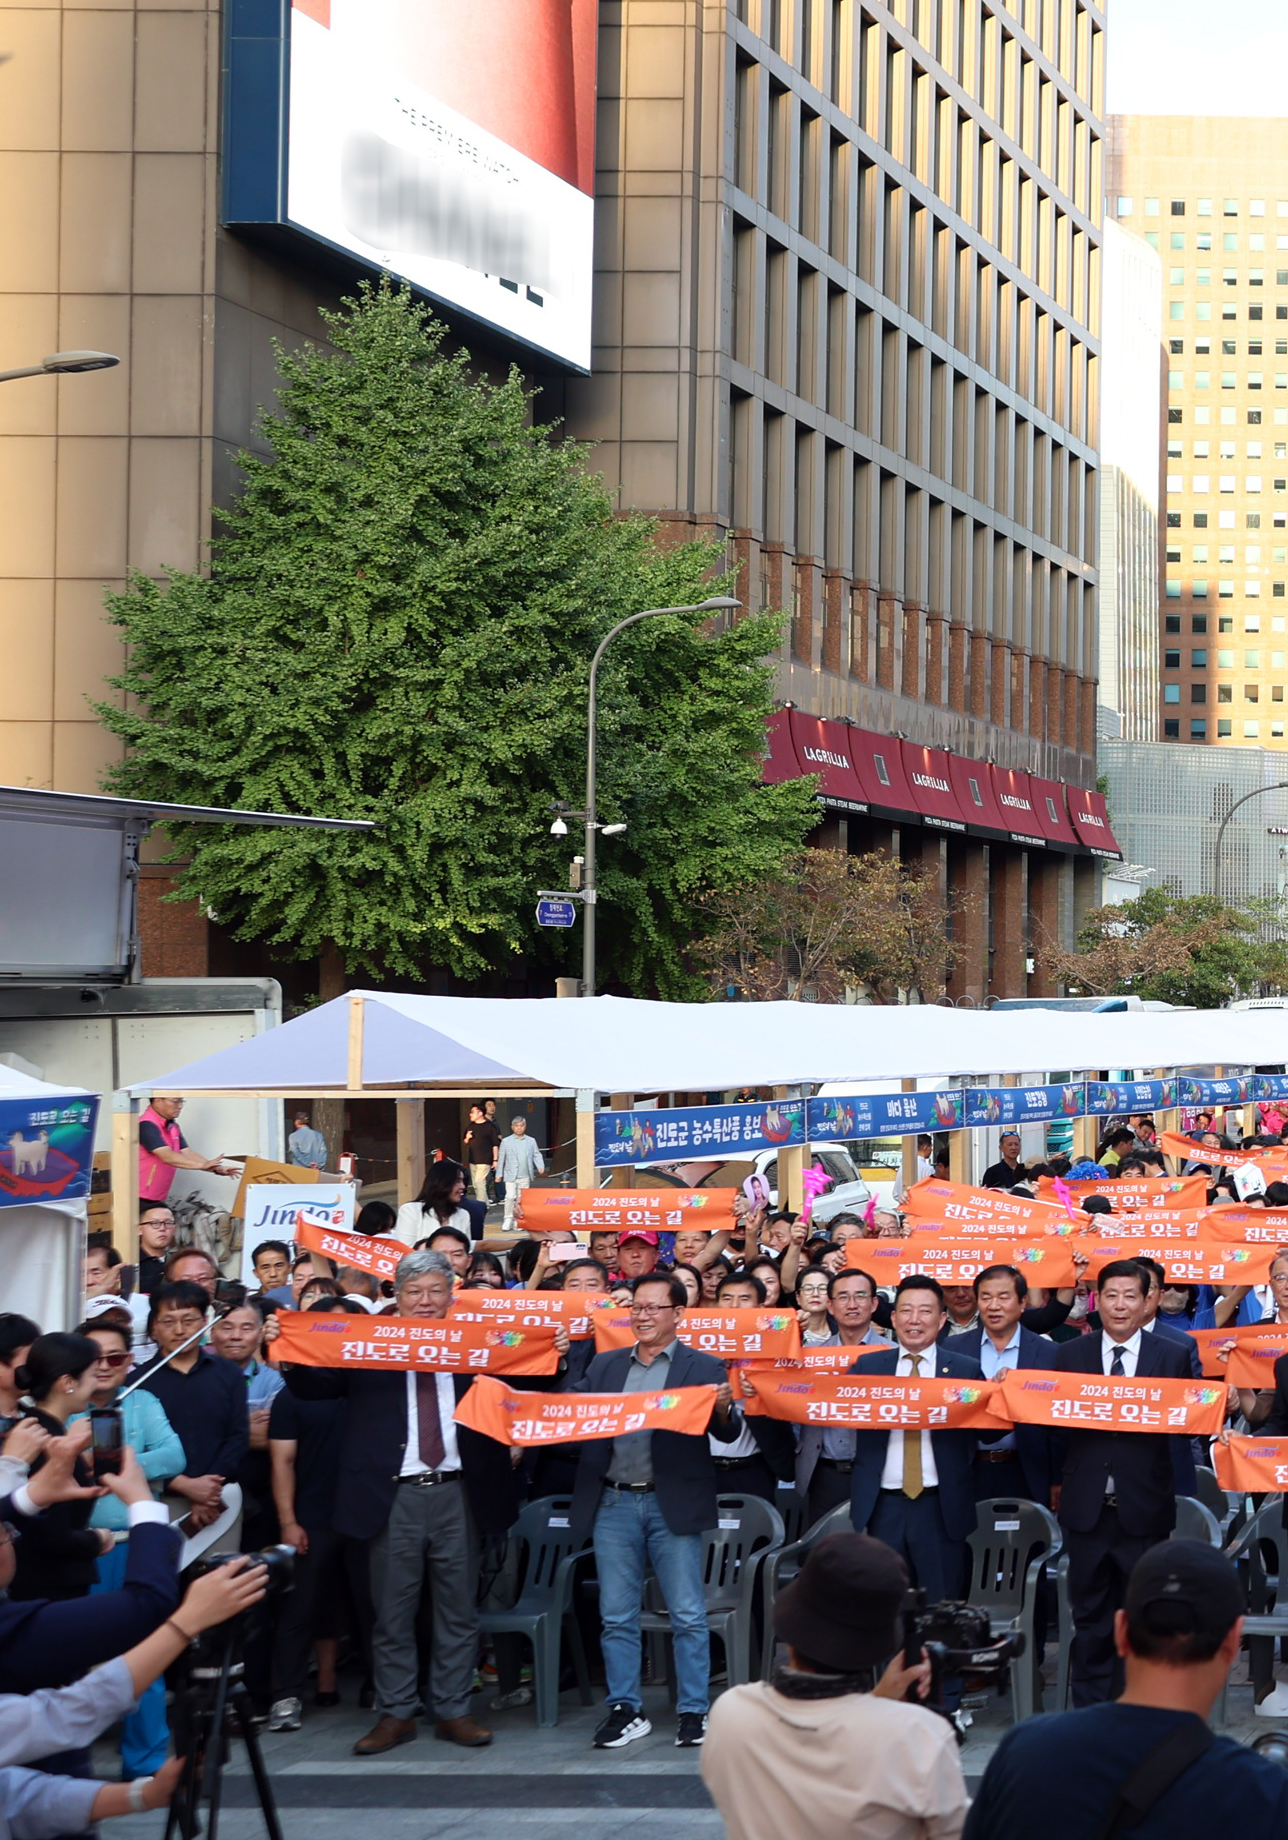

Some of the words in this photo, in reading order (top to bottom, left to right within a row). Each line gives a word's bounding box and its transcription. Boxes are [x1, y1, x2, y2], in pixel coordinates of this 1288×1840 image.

[804, 746, 850, 768] LAGRILLIA
[912, 772, 949, 792] LAGRILLIA
[1000, 794, 1031, 810] LAGRILLIA
[29, 1109, 57, 1126] 진도로
[59, 1111, 79, 1124] 오는
[81, 1108, 90, 1123] 길
[656, 1122, 689, 1148] 진도군
[693, 1115, 741, 1145] 농수특산품
[743, 1115, 762, 1140] 홍보
[592, 1197, 617, 1207] 2024
[619, 1197, 648, 1207] 진도의
[649, 1197, 661, 1207] 날
[569, 1210, 621, 1225] 진도로
[626, 1211, 660, 1225] 오는
[666, 1210, 682, 1225] 길
[310, 1320, 350, 1334] Jindo
[373, 1325, 406, 1338] 2024
[409, 1327, 447, 1341] 진도의
[450, 1330, 463, 1343] 날
[341, 1341, 410, 1362] 진도로
[416, 1346, 461, 1365] 오는
[468, 1348, 490, 1366] 길
[775, 1382, 812, 1395] Jindo
[836, 1386, 867, 1398] 2024
[870, 1387, 906, 1400] 진도의
[909, 1388, 922, 1401] 날
[1022, 1379, 1059, 1391] Jindo
[1080, 1384, 1109, 1397] 2024
[1112, 1386, 1147, 1400] 진도의
[1150, 1388, 1162, 1401] 날
[806, 1402, 872, 1422] 진도로
[877, 1404, 920, 1423] 오는
[927, 1406, 948, 1423] 길
[1050, 1400, 1113, 1421] 진도로
[1118, 1404, 1161, 1424] 오는
[1168, 1406, 1188, 1425] 길
[1244, 1446, 1279, 1460] Jindo
